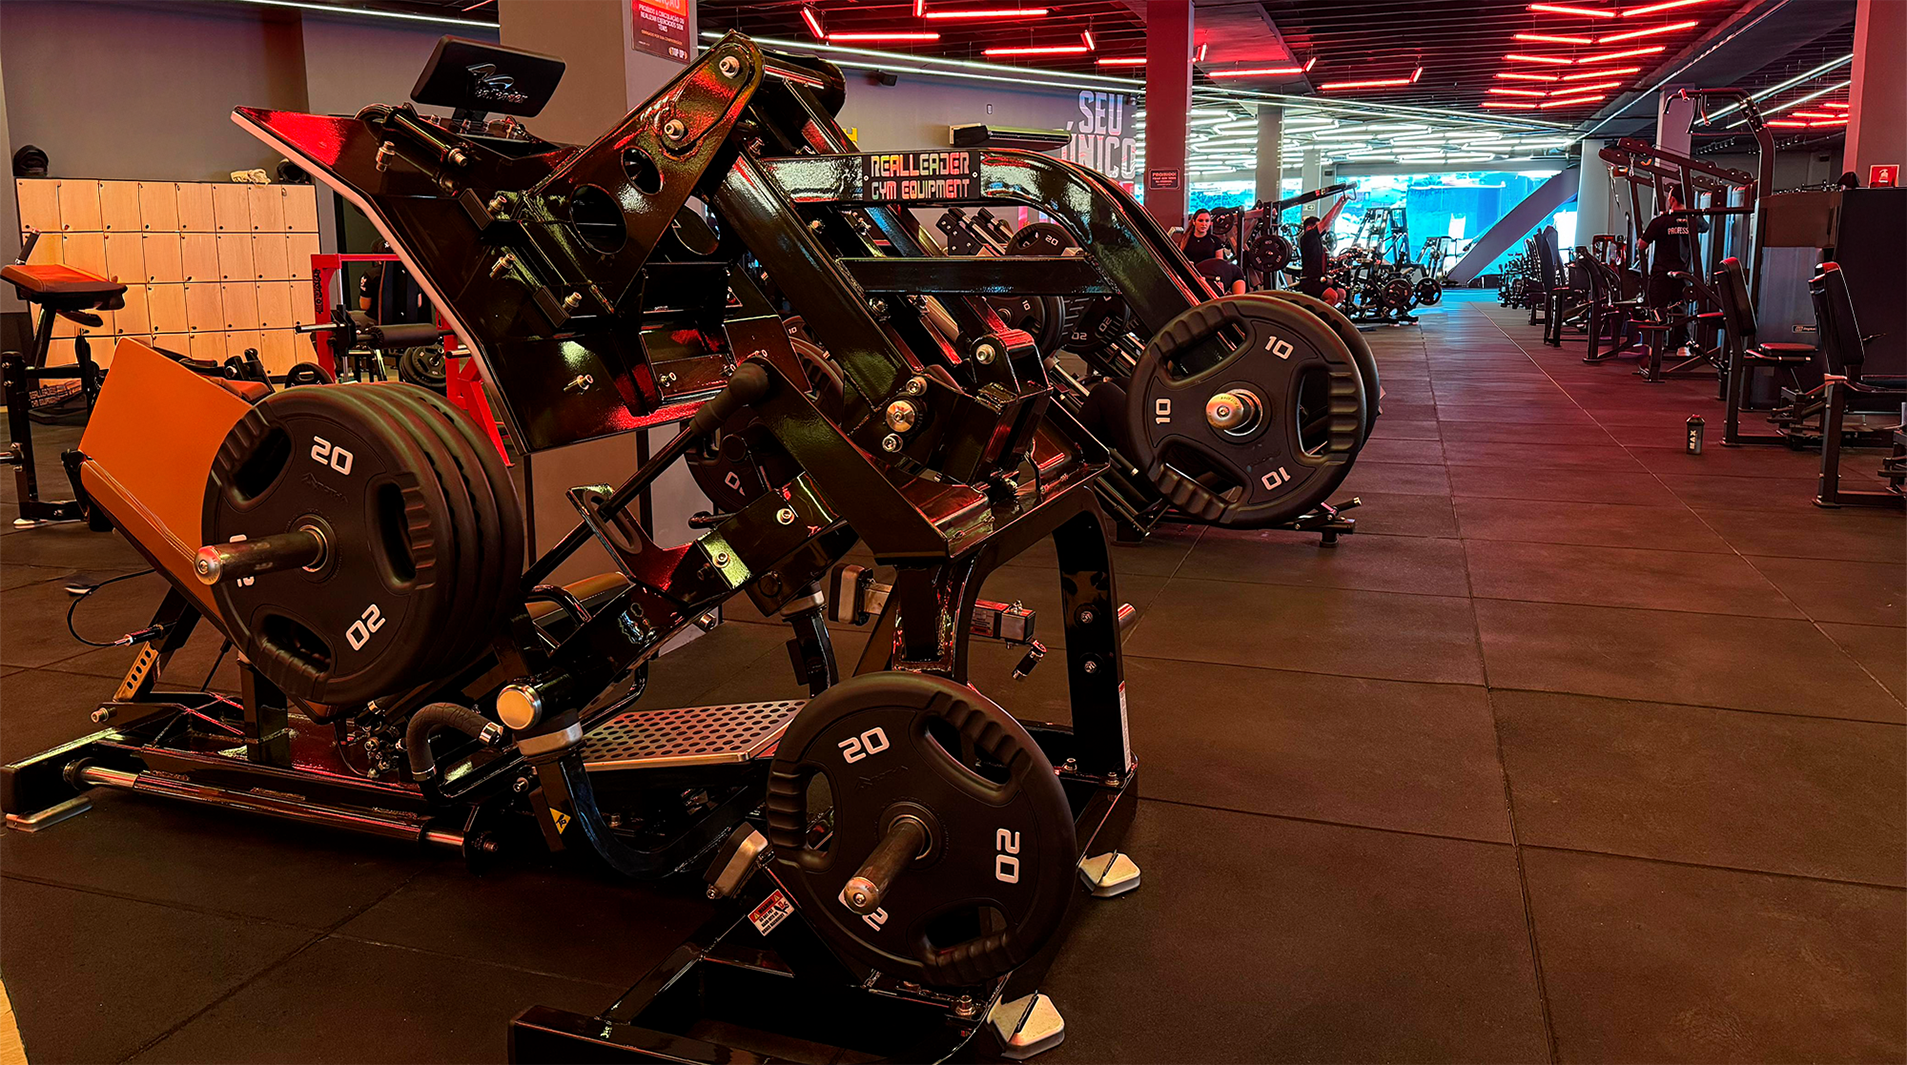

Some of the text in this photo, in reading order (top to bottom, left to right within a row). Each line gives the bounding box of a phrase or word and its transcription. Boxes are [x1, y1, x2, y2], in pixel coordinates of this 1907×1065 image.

[1078, 90, 1124, 136] SEU
[1061, 121, 1137, 180] ÚNICO
[870, 152, 970, 177] REALLEADER
[871, 178, 970, 200] GYM EQUIPMENT
[1045, 234, 1059, 247] 20
[1667, 226, 1690, 235] PROFESS
[1021, 300, 1031, 311] 10
[1264, 335, 1294, 360] 10
[1155, 398, 1171, 425] 10
[310, 435, 355, 476] 20
[1261, 466, 1291, 491] 10
[345, 603, 387, 651] 20
[837, 725, 891, 765] 20
[994, 827, 1021, 884] 20
[837, 889, 889, 932] 2
